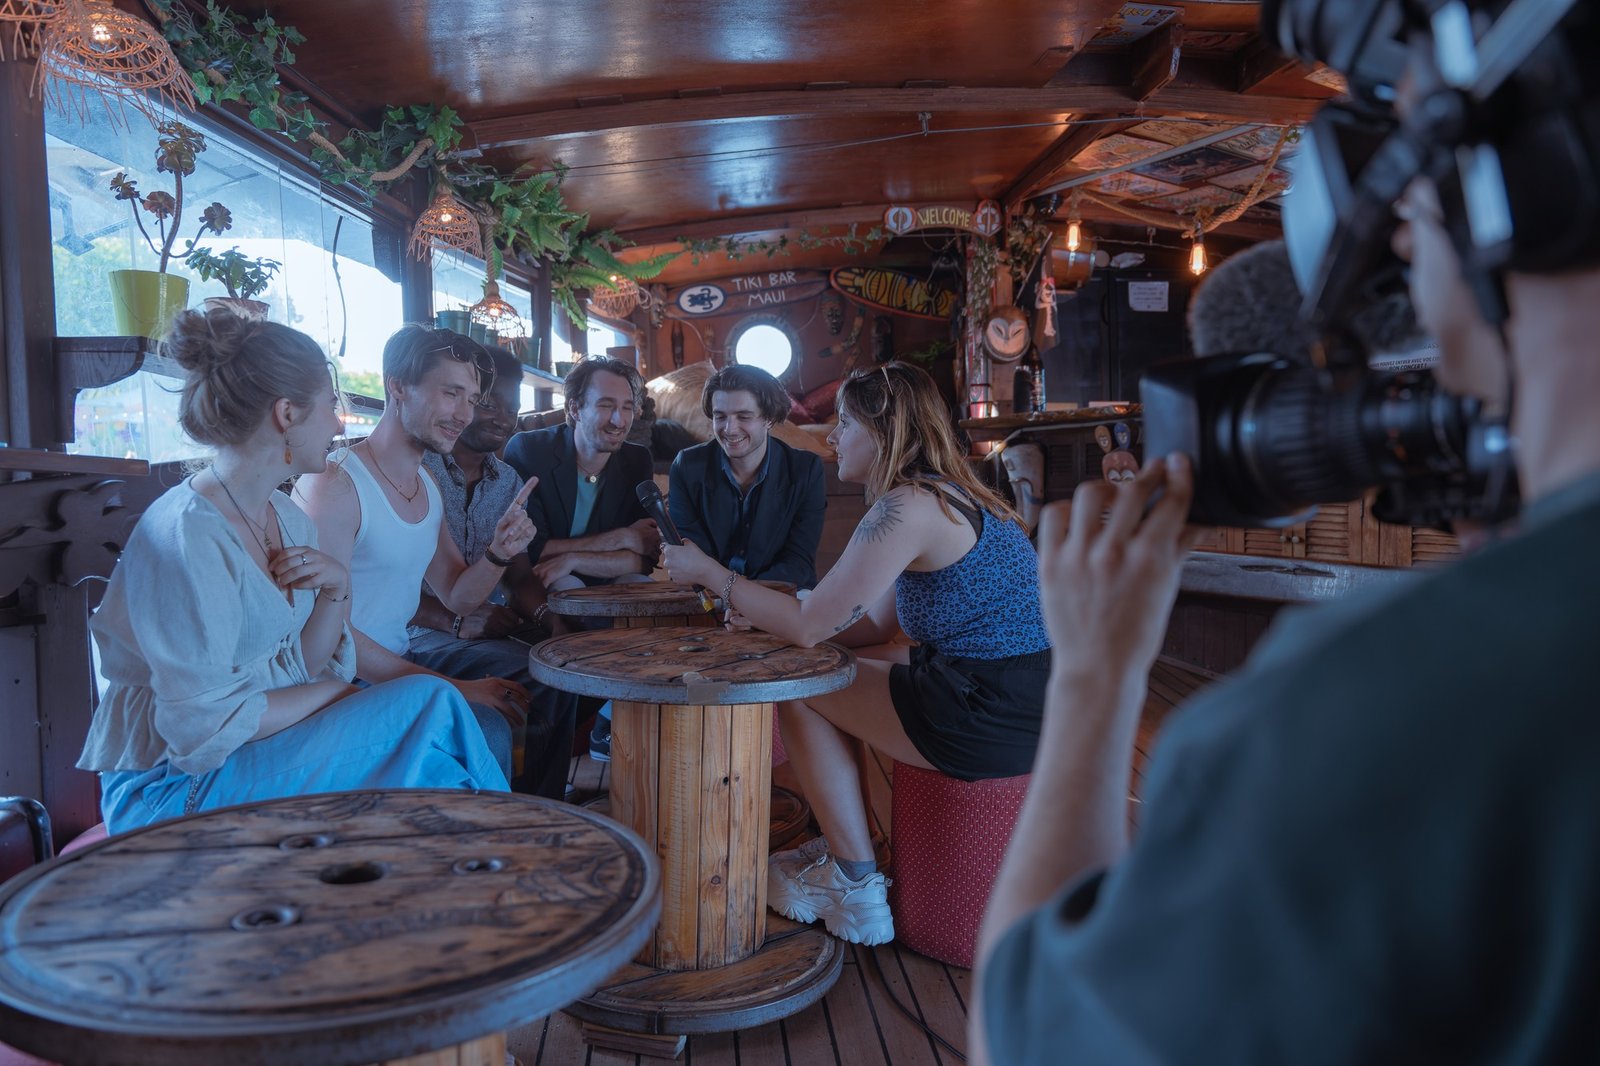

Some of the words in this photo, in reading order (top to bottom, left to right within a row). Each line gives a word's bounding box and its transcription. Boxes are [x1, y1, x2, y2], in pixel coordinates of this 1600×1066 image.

[917, 207, 971, 228] WELCOME
[731, 276, 762, 291] TIKI
[769, 271, 797, 286] BAR
[748, 290, 786, 306] MAUI
